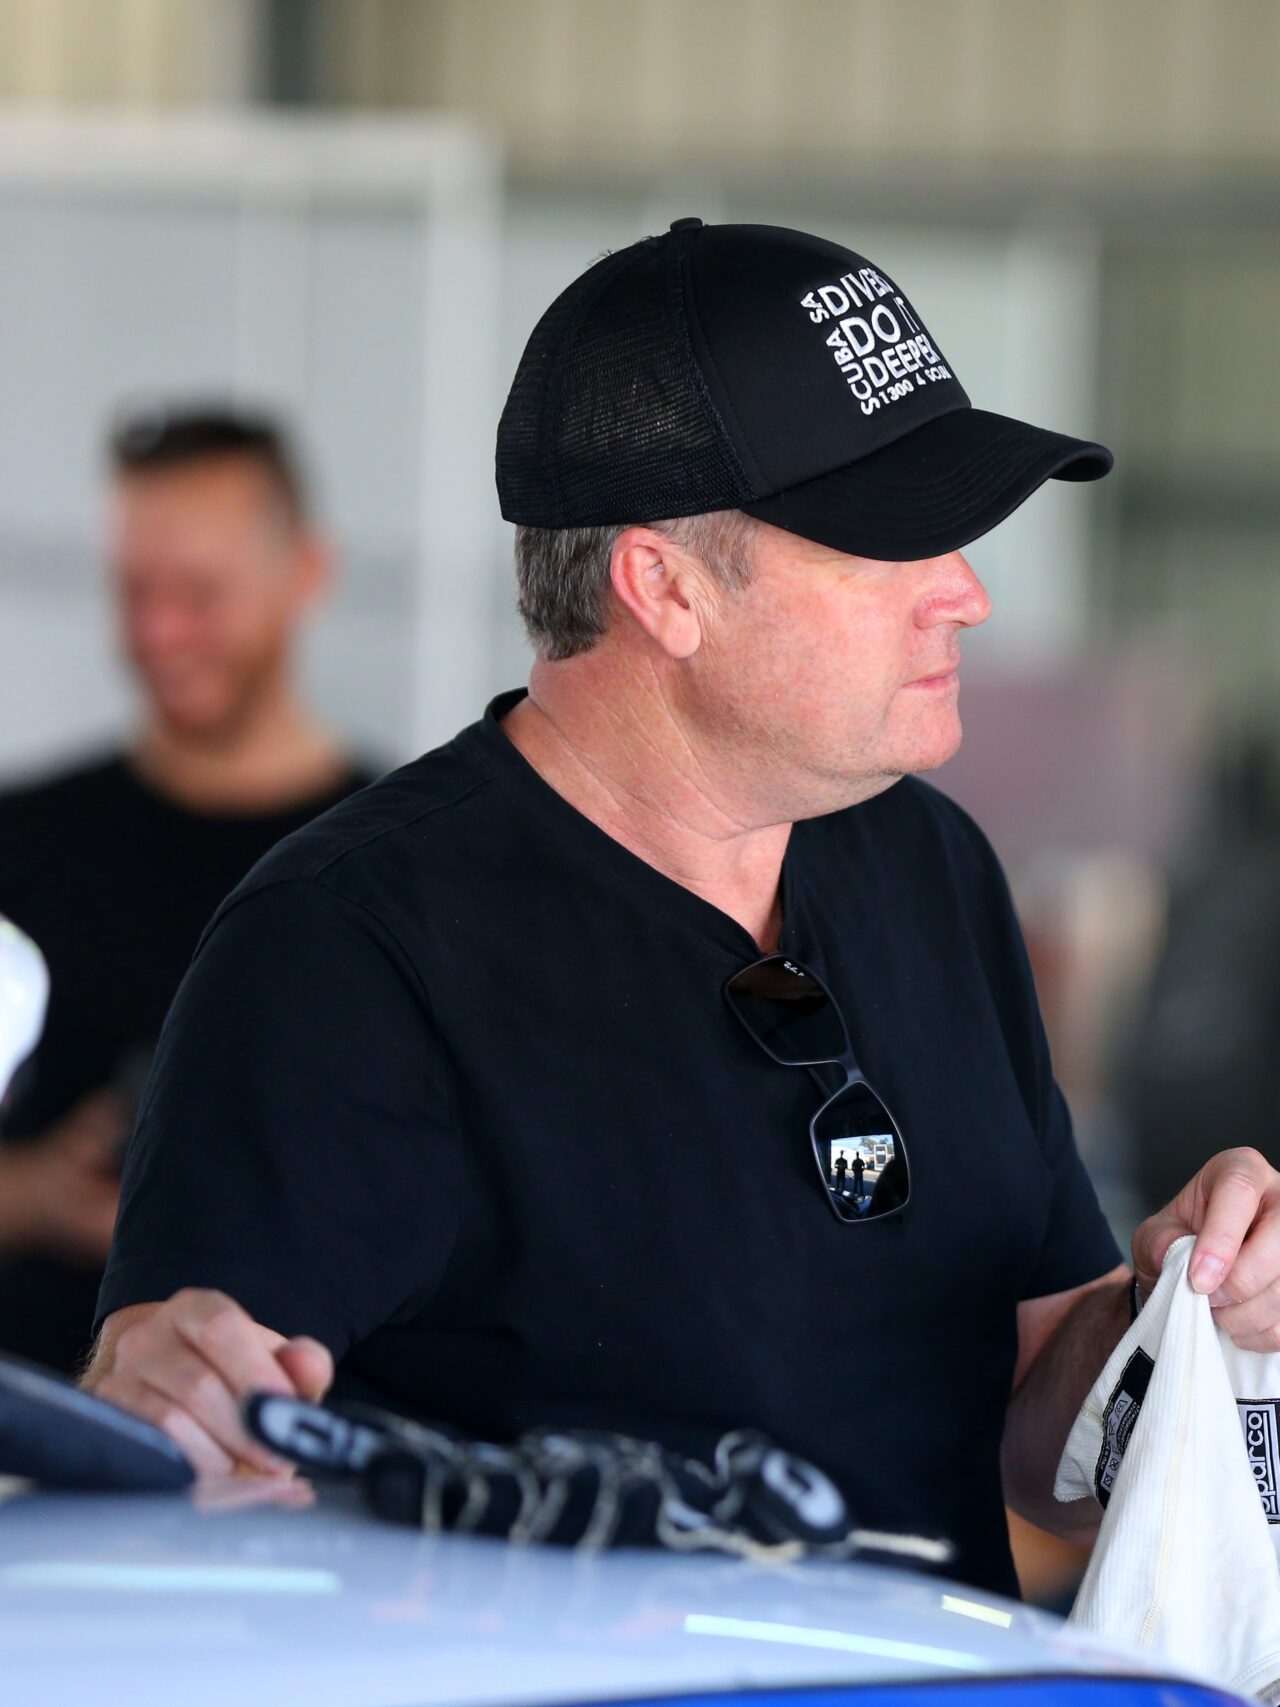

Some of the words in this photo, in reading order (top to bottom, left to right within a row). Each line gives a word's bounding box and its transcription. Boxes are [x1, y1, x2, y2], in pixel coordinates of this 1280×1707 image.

[839, 303, 901, 357] DO
[892, 296, 921, 334] IT
[825, 327, 881, 416] SCUBA
[861, 333, 941, 388] DEEPER
[878, 380, 915, 405] 1300
